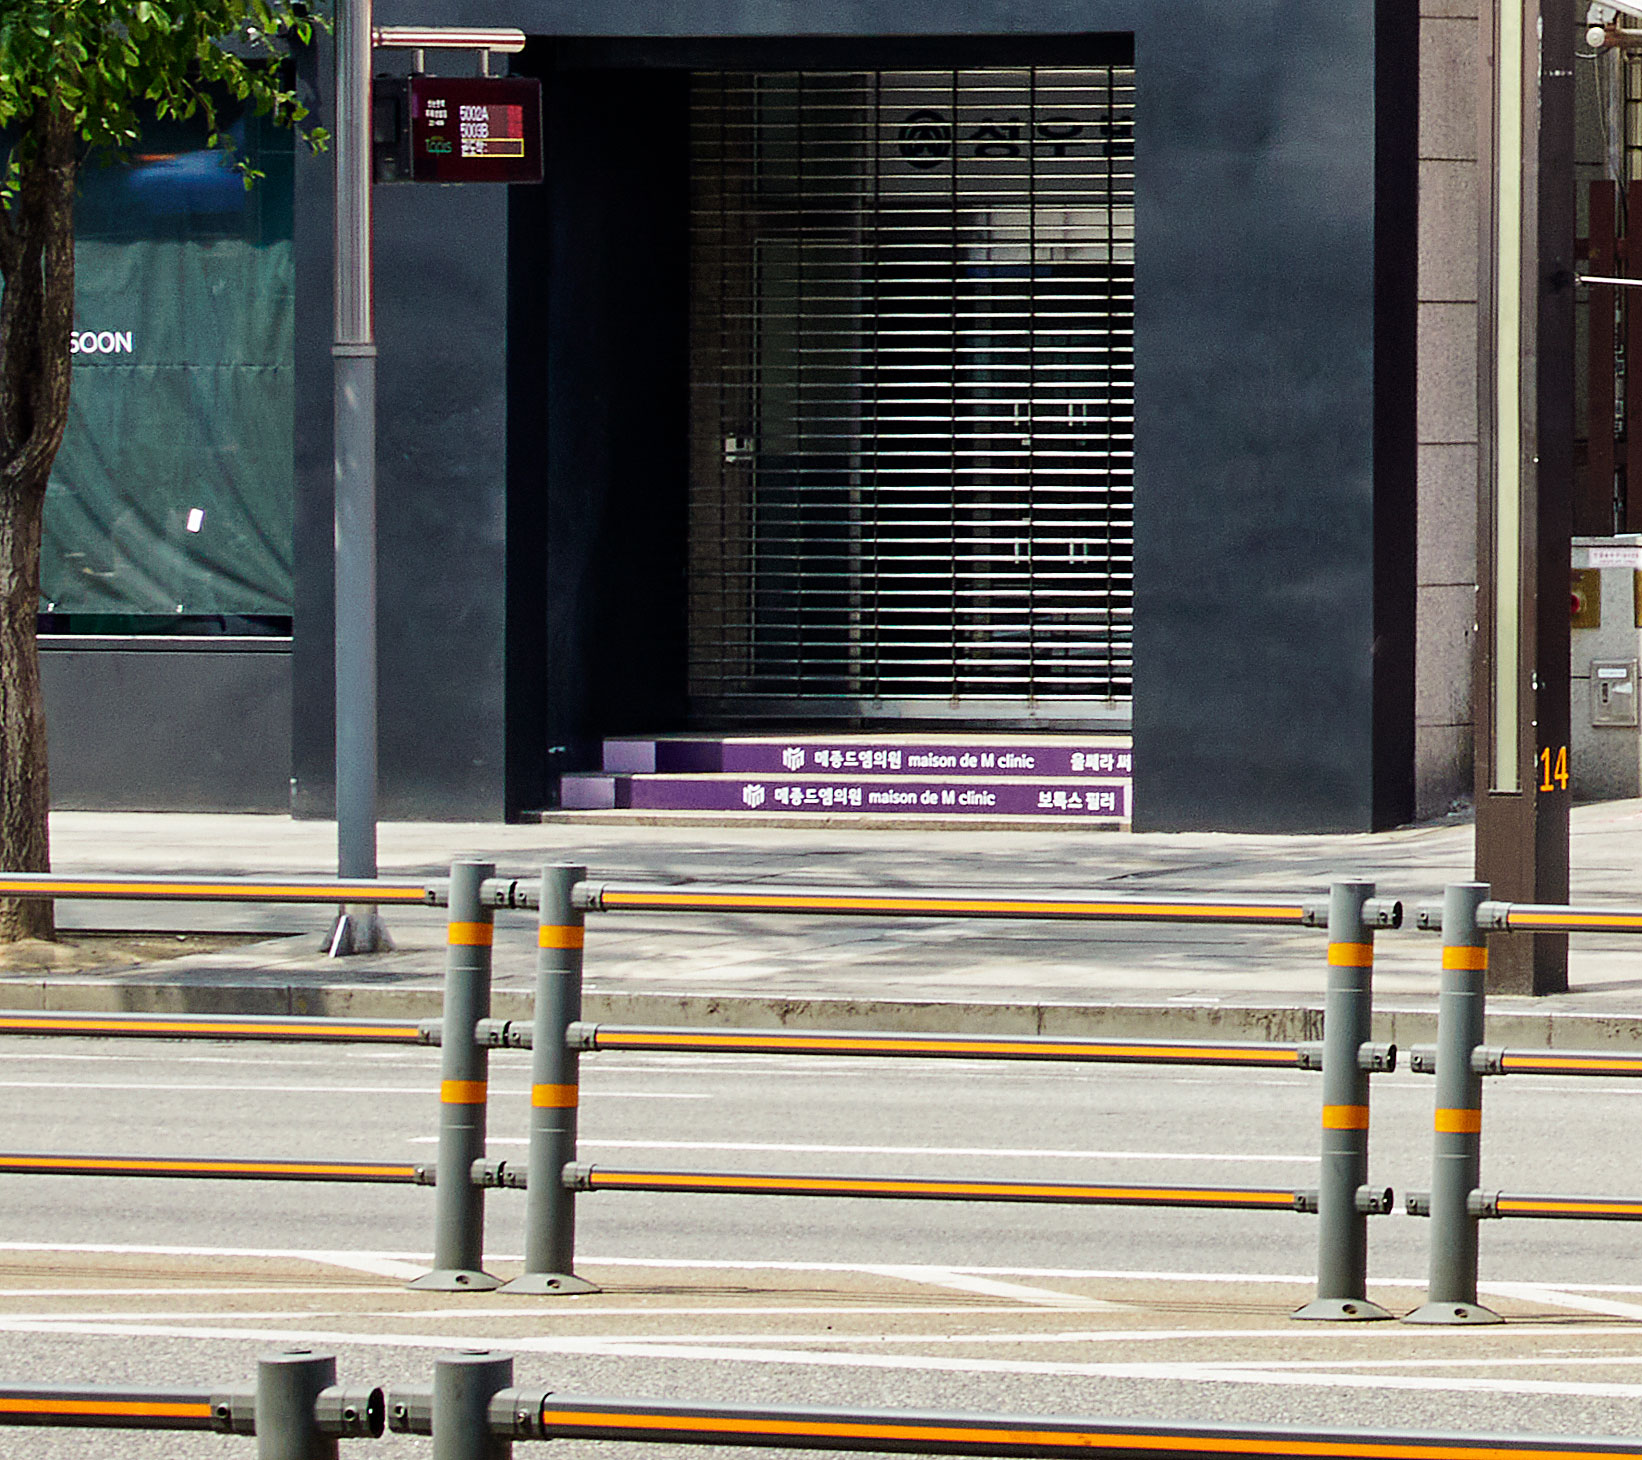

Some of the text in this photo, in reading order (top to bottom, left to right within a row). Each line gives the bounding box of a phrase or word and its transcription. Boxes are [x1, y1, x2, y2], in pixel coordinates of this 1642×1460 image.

[69, 331, 133, 354] SOON
[908, 752, 1036, 770] maison de M clinic
[1540, 745, 1569, 792] 14
[868, 790, 997, 807] maison de M clinic
